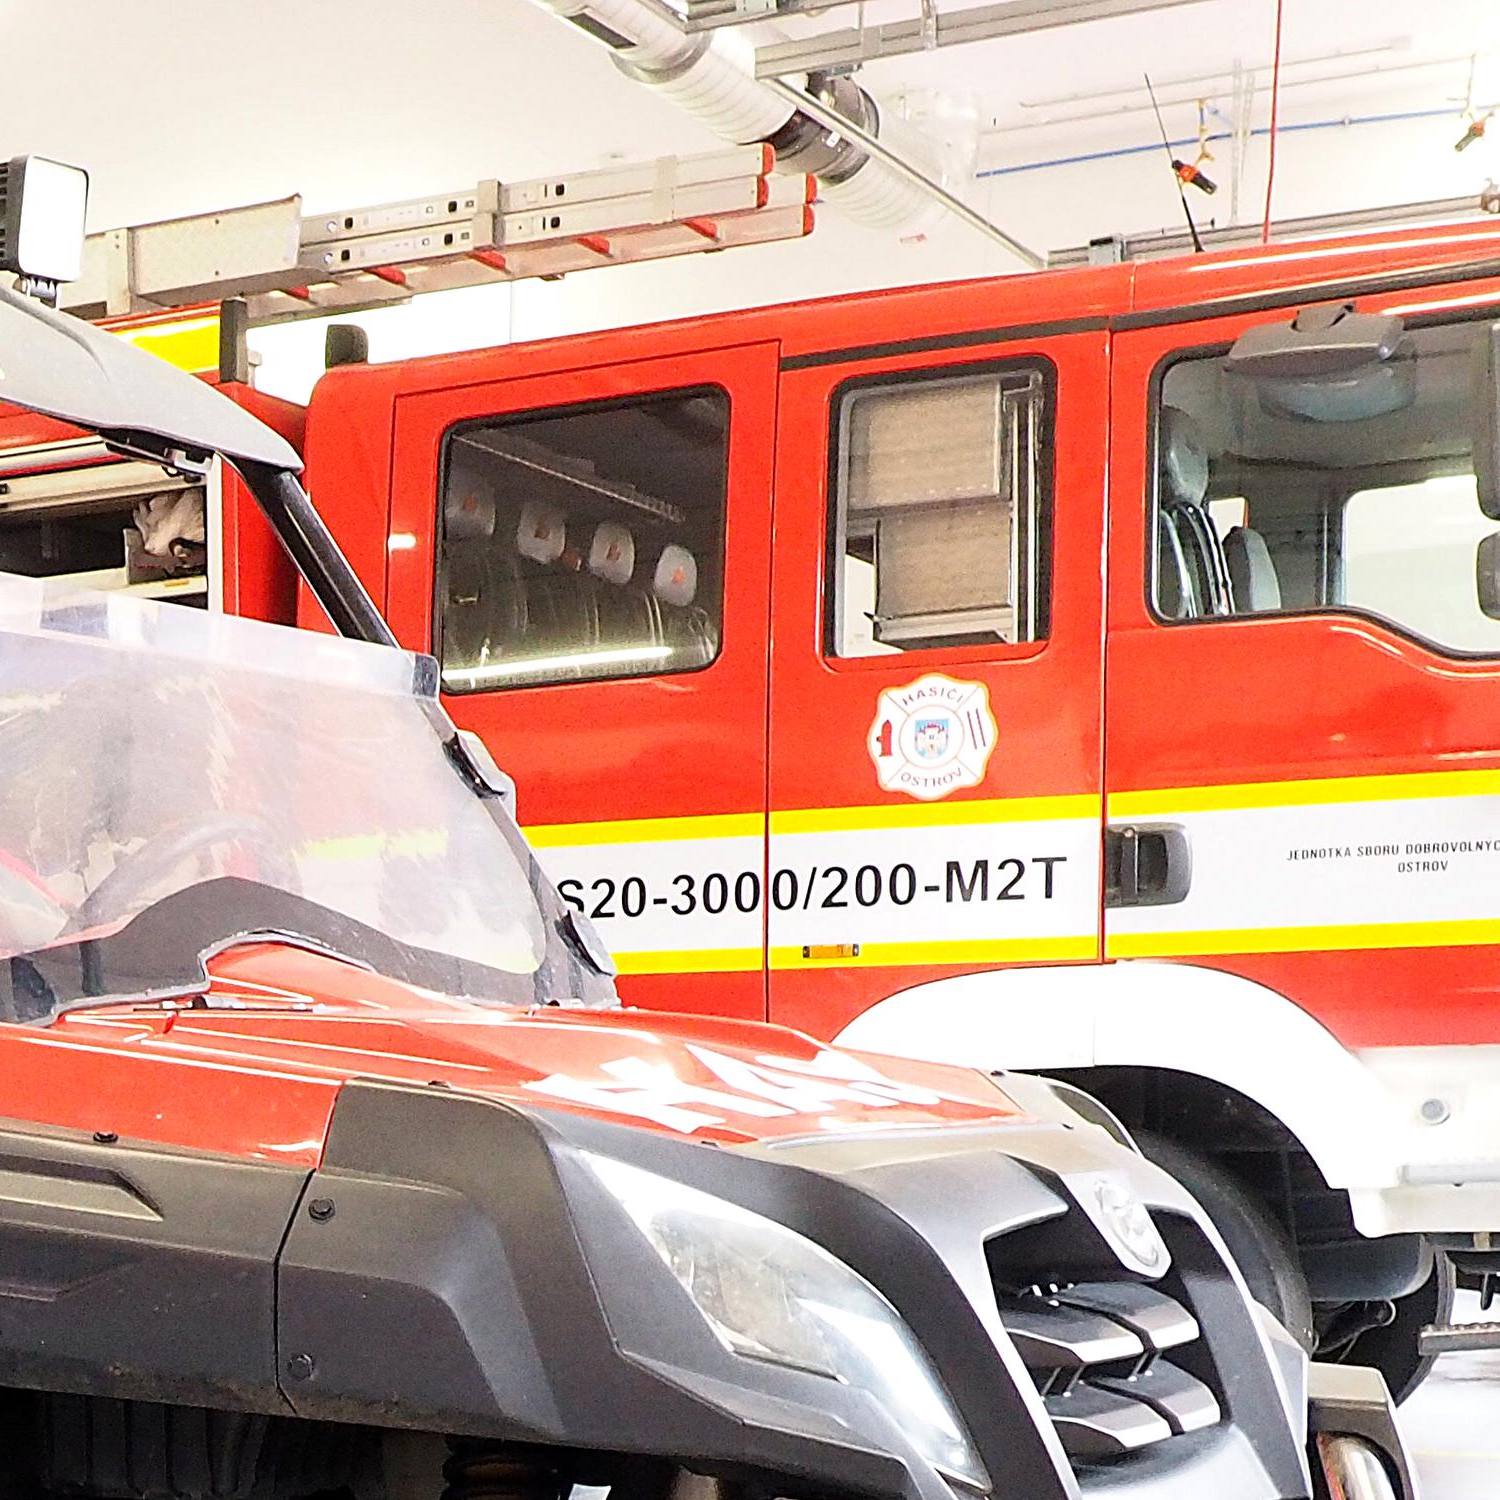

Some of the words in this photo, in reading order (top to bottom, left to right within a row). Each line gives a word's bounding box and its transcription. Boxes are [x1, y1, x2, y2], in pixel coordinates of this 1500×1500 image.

[900, 767, 962, 788] OSTROV
[1286, 848, 1352, 861] JEDNOTKA
[1357, 844, 1400, 857] SBORU
[1398, 860, 1449, 873] OSTROV
